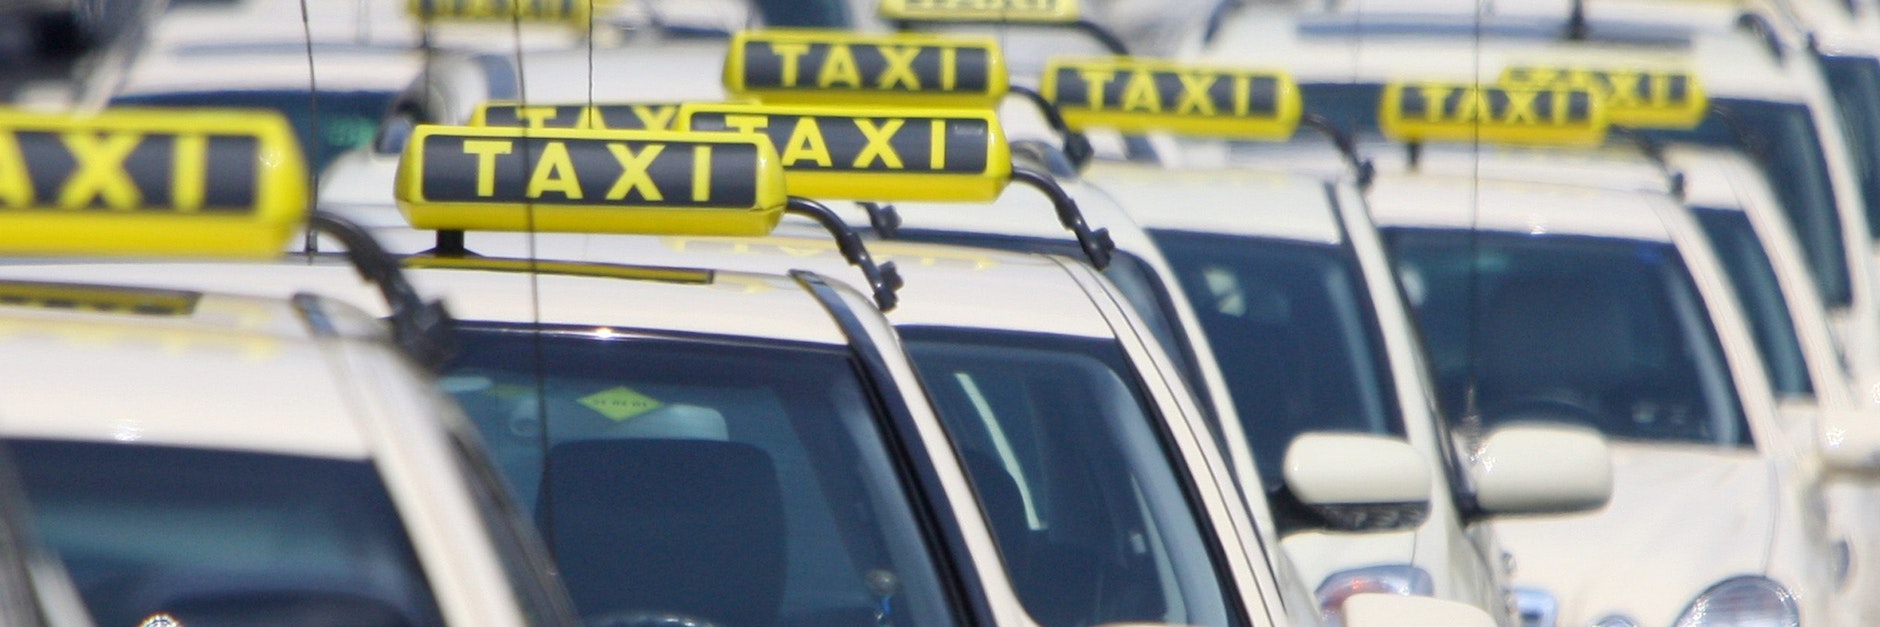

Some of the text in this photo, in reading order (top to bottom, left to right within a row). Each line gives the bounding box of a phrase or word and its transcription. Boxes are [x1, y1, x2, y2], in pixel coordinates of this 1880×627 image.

[770, 44, 958, 91] TAXI
[1078, 73, 1251, 116] TAXI
[1419, 88, 1569, 124] TAXI
[463, 140, 713, 202] TAXI
